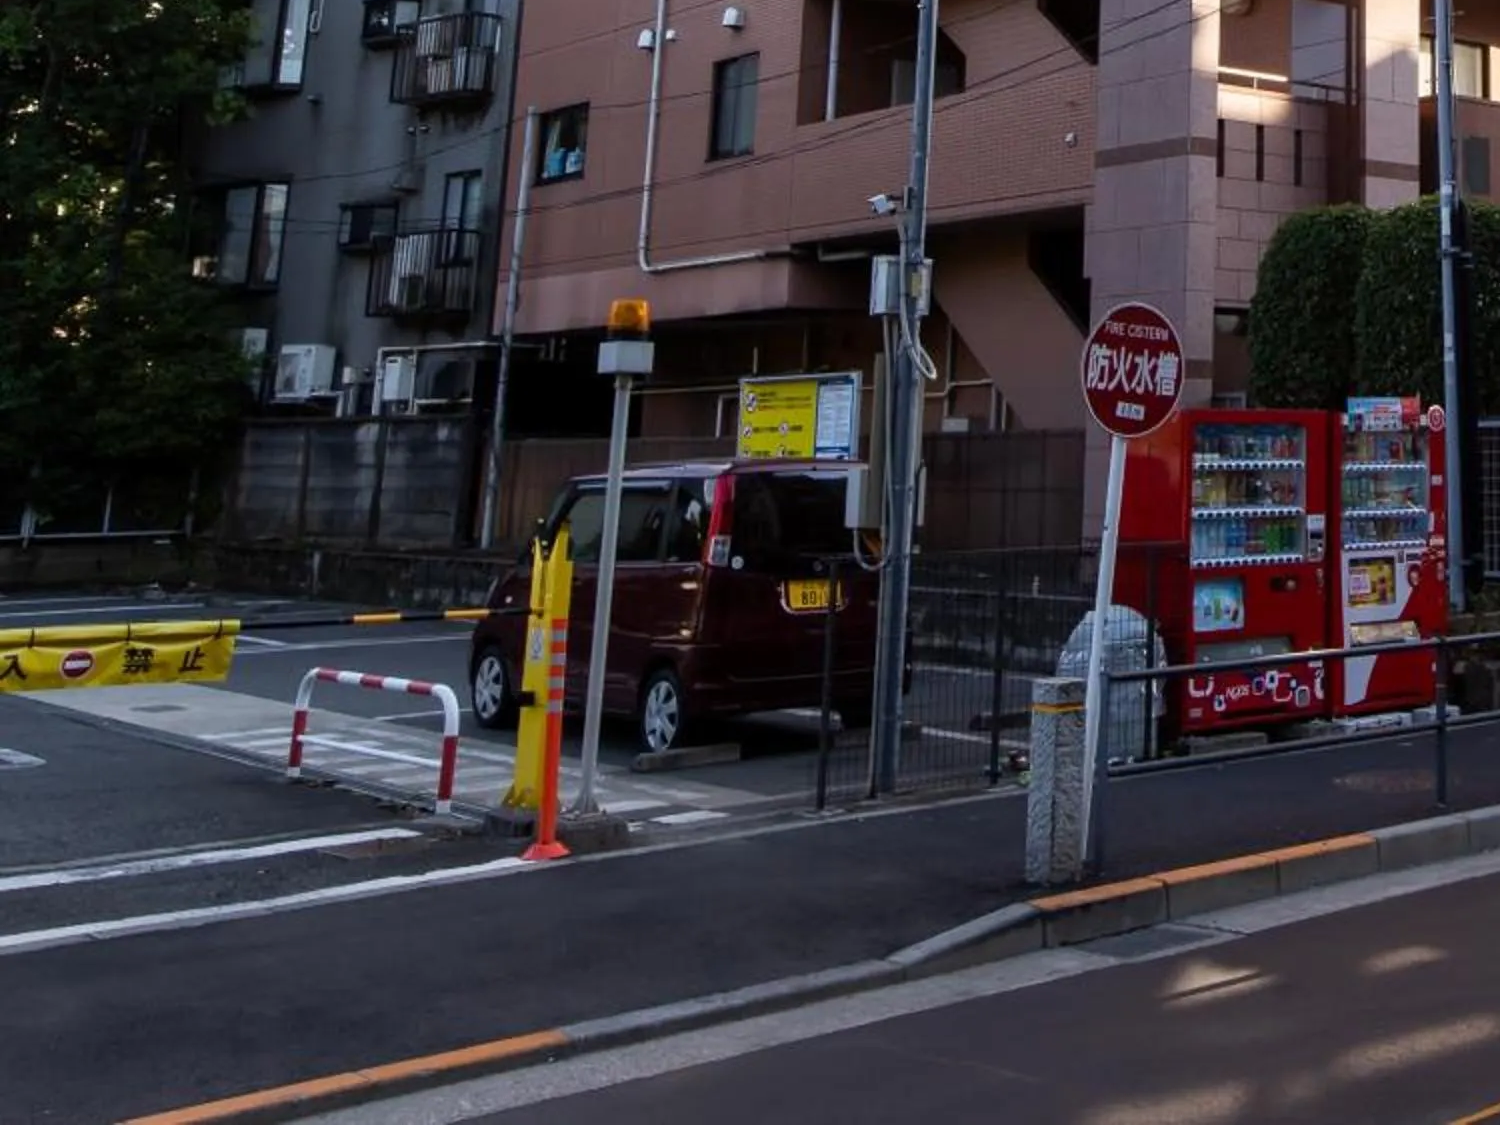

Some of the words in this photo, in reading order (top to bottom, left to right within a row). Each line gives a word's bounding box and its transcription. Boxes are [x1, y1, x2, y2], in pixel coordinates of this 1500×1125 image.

[1105, 321, 1126, 336] FIRE
[1087, 343, 1179, 396] 防火水槽
